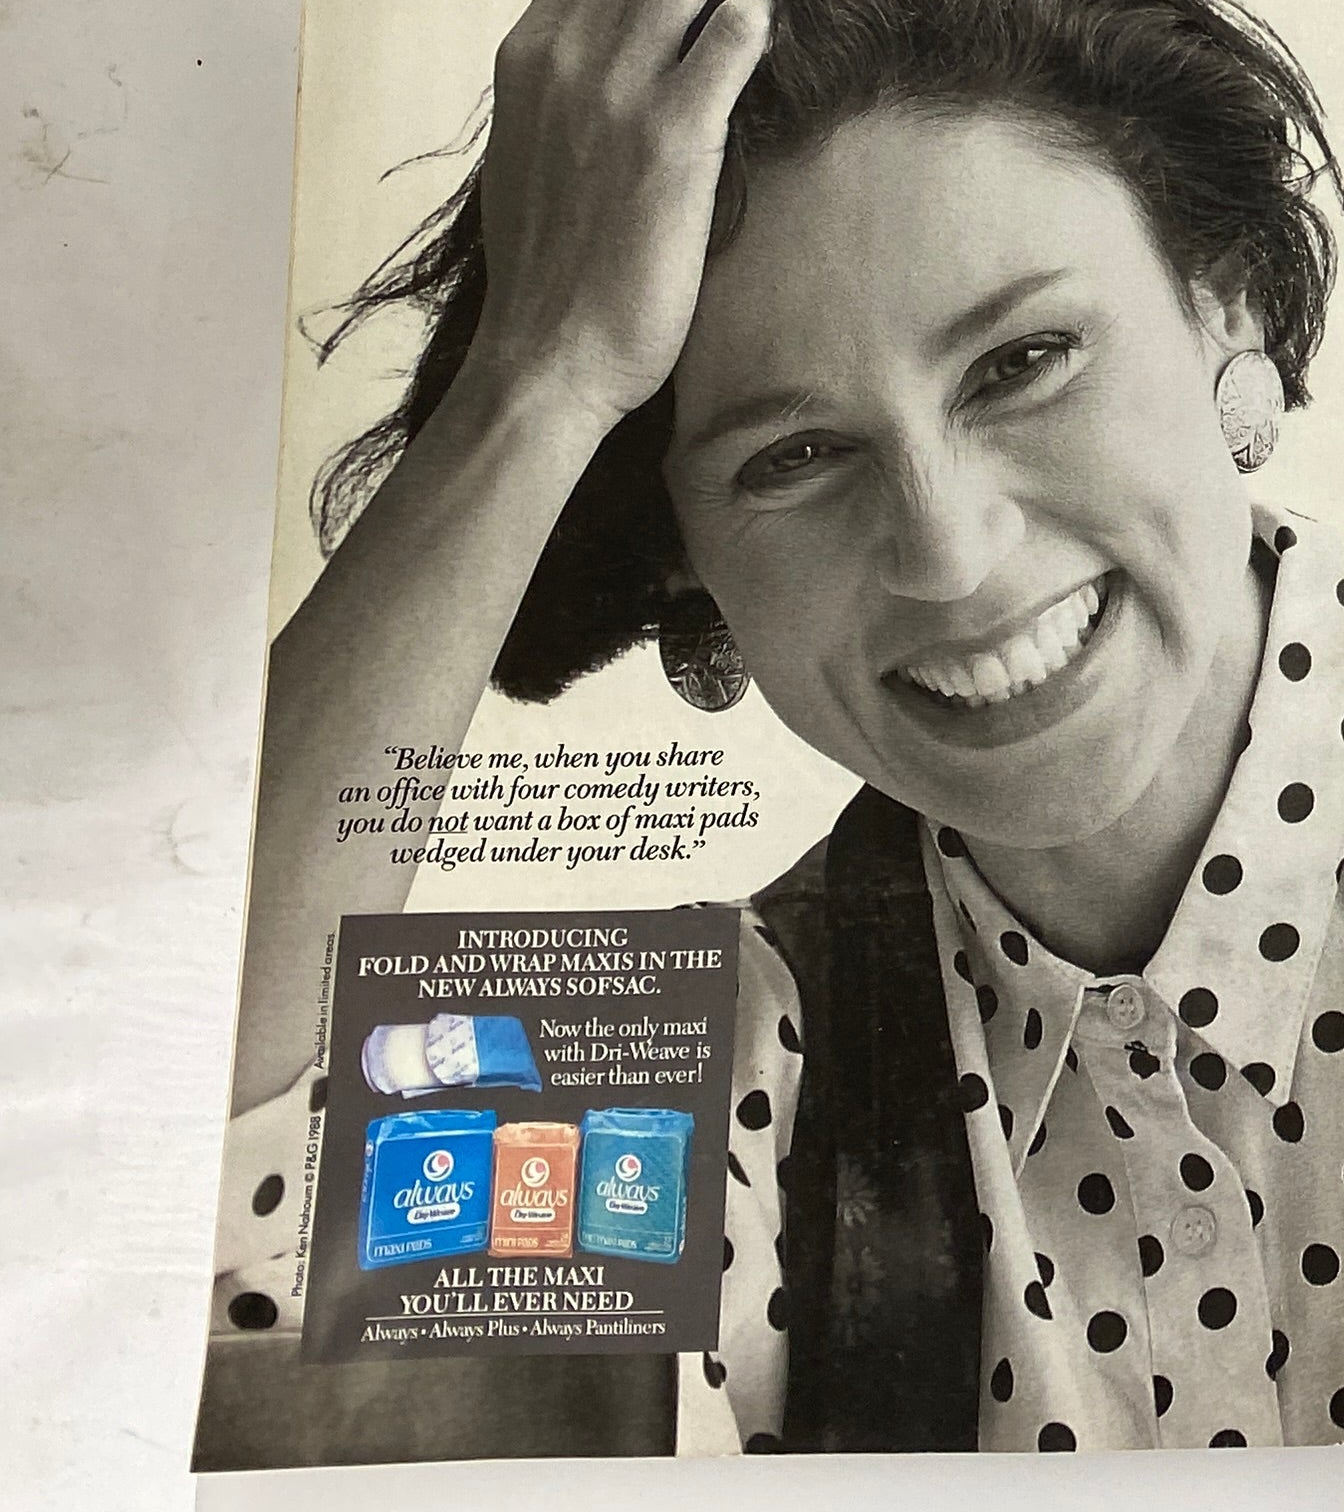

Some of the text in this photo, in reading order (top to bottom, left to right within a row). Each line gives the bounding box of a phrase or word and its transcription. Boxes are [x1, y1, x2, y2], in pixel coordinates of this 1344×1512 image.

[488, 753, 528, 773] me,
[535, 744, 599, 768] when
[604, 752, 651, 776] you
[656, 742, 724, 767] share
[457, 928, 628, 949] INTRODUCING
[359, 950, 722, 976] FOLD AND WRAP MAXIS IN THE
[317, 967, 332, 1004] limited
[418, 975, 661, 998] NEW ALWAYS SOFSAC.
[313, 1019, 328, 1070] Available
[307, 1115, 322, 1142] 1988
[305, 1143, 319, 1171] P&G
[394, 1179, 475, 1210] always
[596, 1176, 660, 1203] always
[295, 1237, 309, 1259] Ken
[291, 1260, 306, 1298] Photo:
[433, 1267, 604, 1288] ALL THE MAXI
[401, 1291, 633, 1314] YOU'LL EVER NEED
